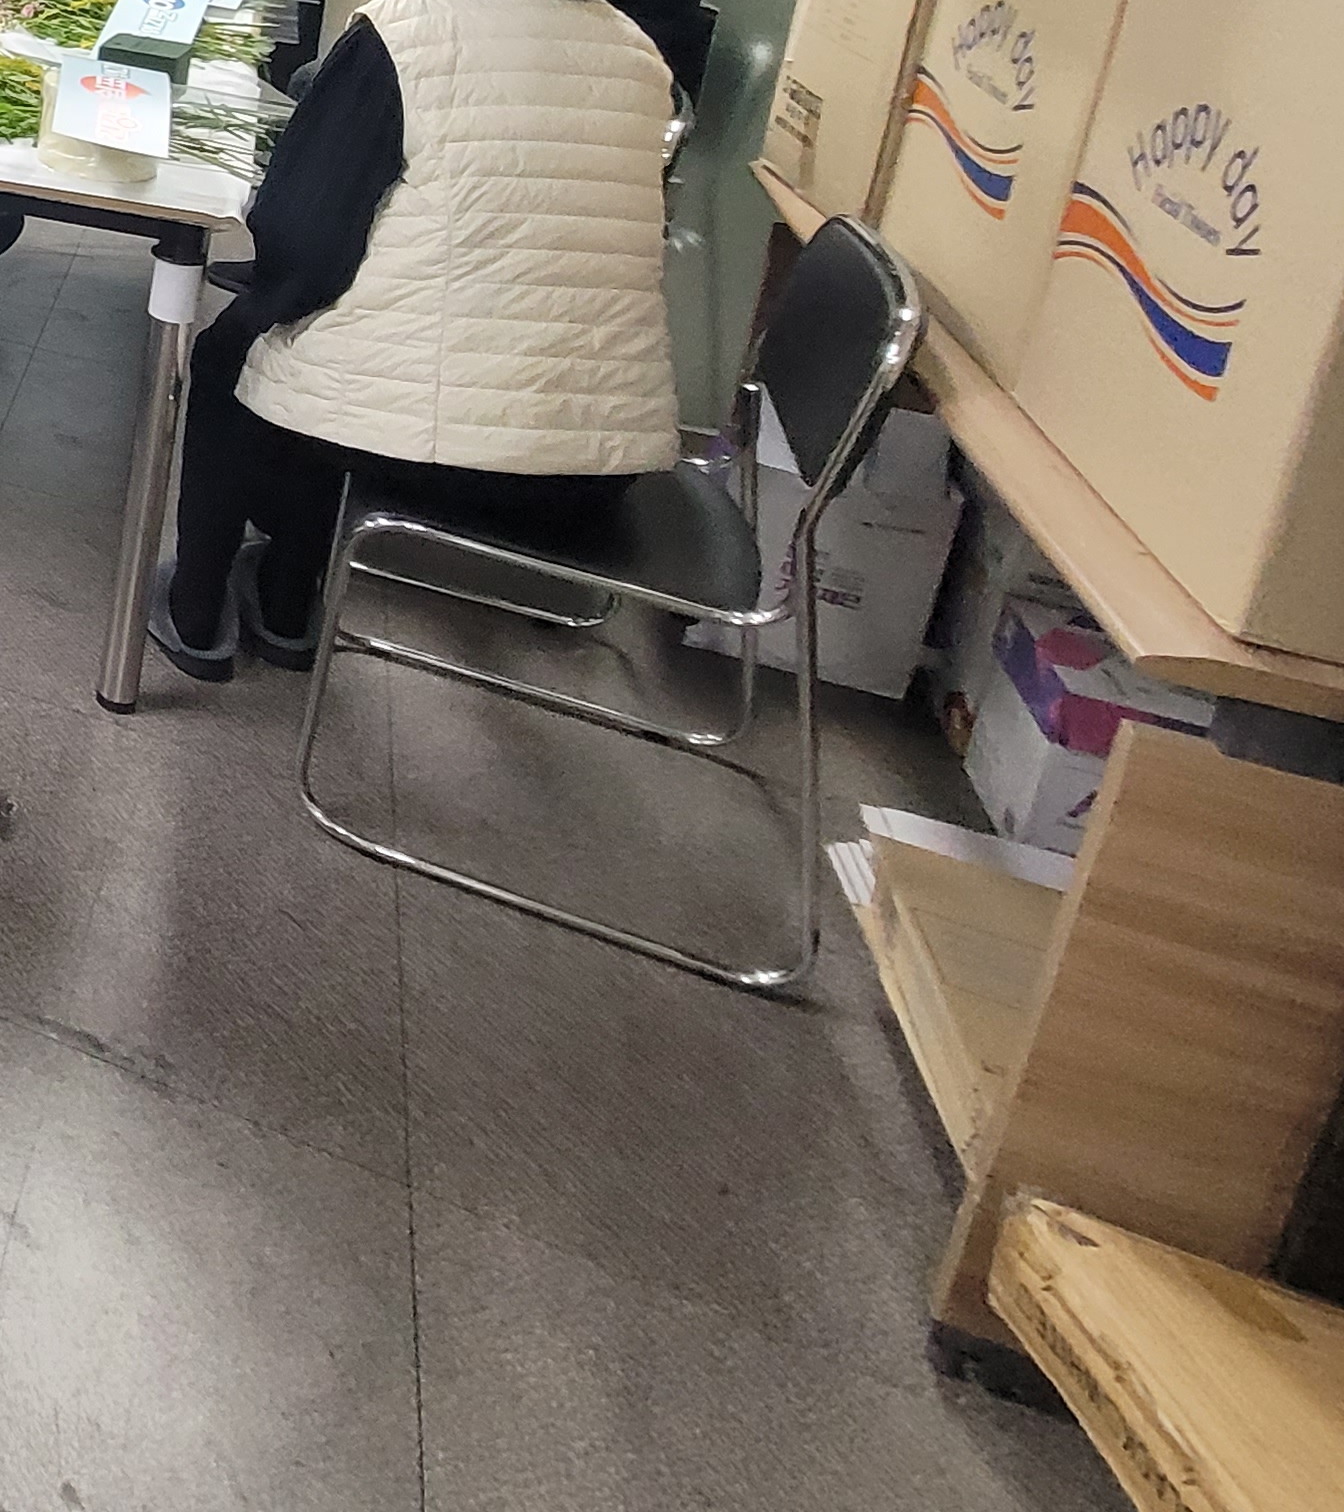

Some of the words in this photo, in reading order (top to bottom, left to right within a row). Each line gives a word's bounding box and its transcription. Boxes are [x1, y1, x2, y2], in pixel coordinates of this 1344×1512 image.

[951, 0, 1018, 71] Happy
[1010, 29, 1036, 112] day
[1127, 102, 1233, 192] Happy
[1221, 145, 1262, 257] day
